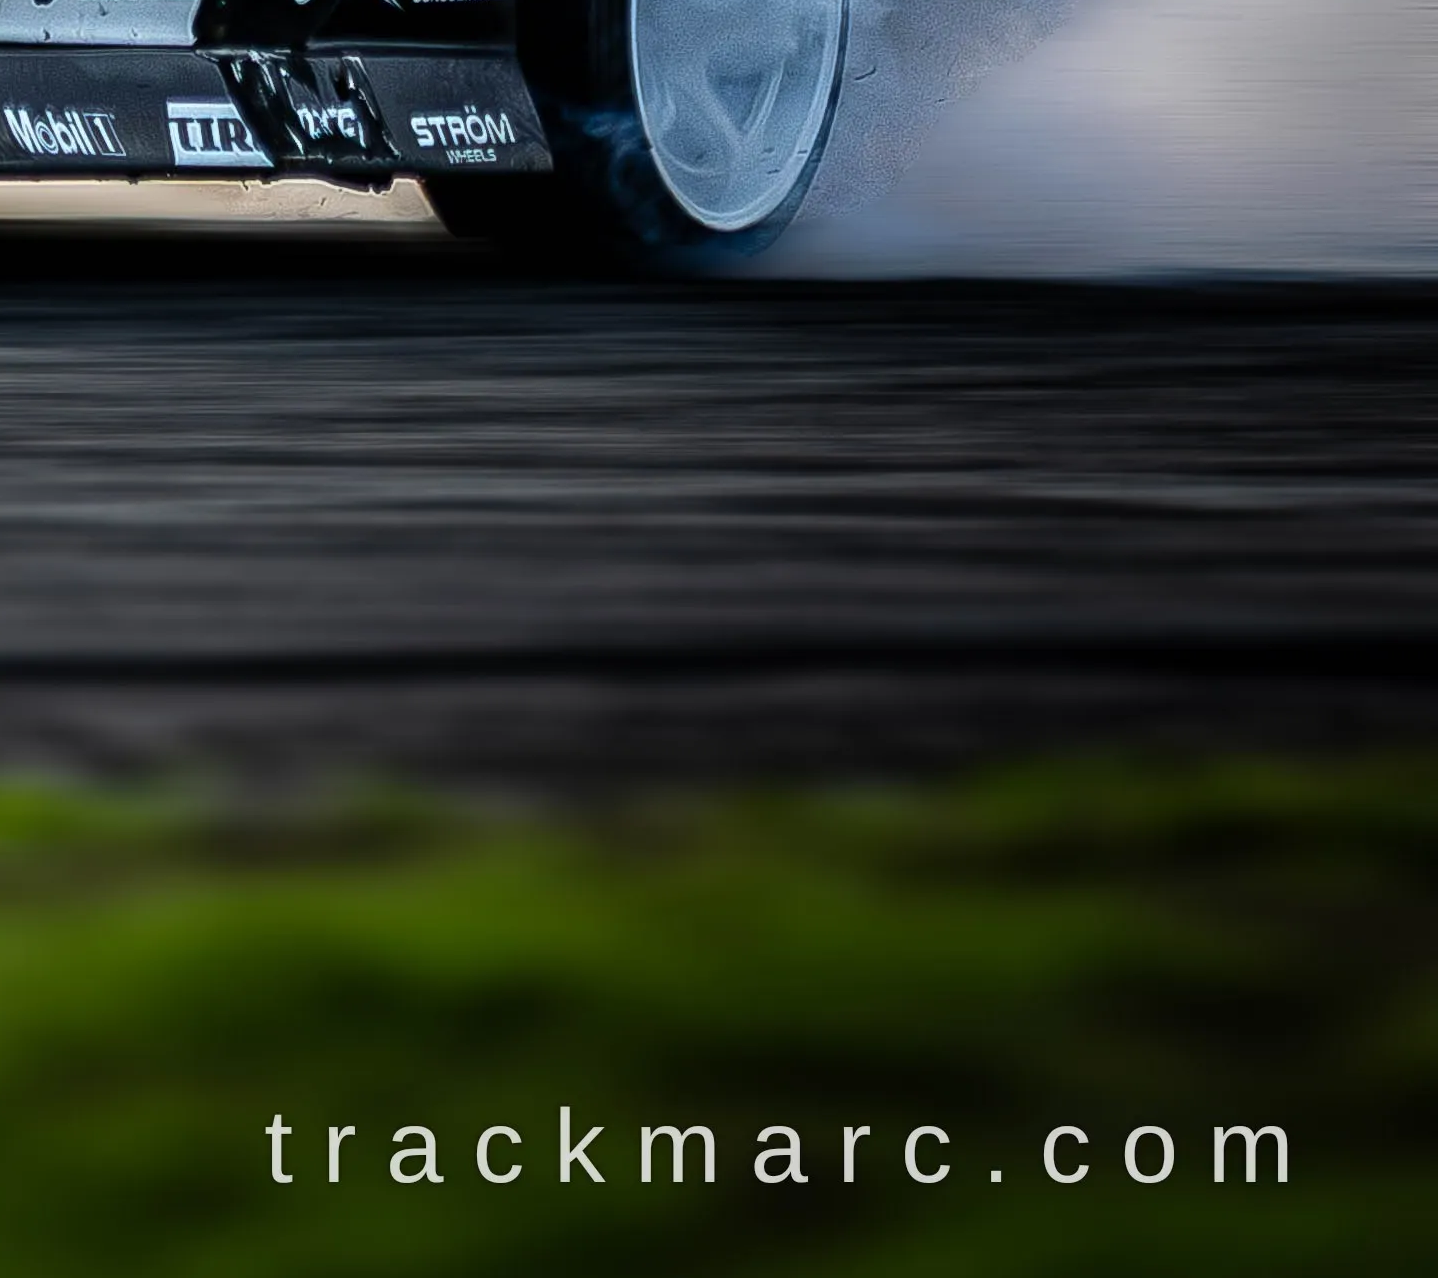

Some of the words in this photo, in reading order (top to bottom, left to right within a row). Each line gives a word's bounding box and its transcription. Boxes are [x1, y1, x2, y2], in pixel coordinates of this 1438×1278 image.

[3, 107, 96, 155] Mobil
[410, 105, 516, 147] STRÖM
[446, 148, 497, 164] WHEELS
